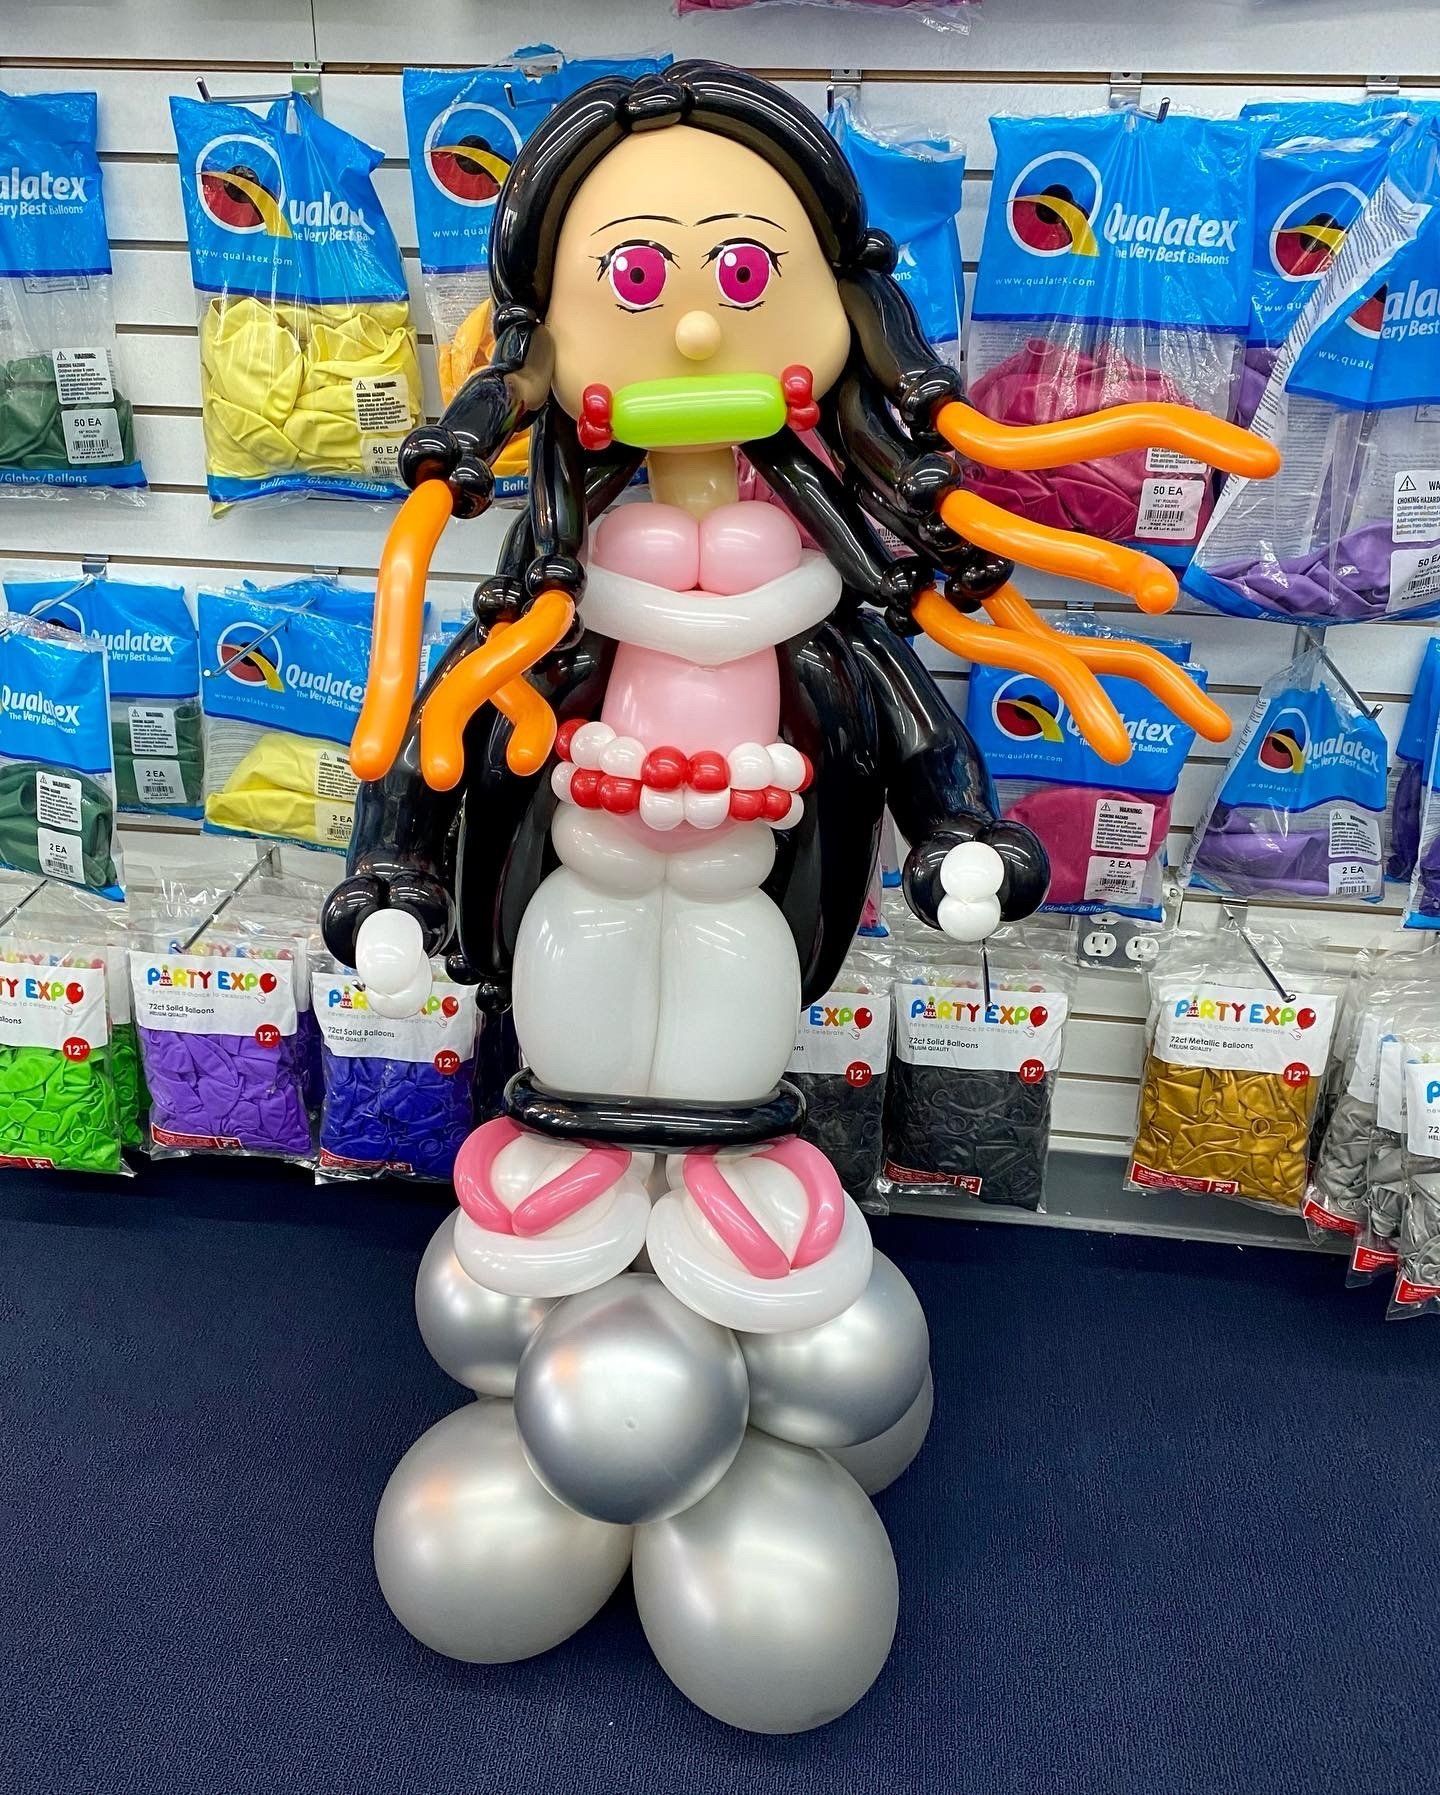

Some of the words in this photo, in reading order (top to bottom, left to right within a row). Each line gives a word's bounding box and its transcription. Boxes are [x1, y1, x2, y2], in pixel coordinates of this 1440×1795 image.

[21, 202, 47, 215] Best
[49, 205, 84, 215] Balloons
[432, 225, 491, 239] www.qual
[1104, 202, 1239, 252] Qualatex
[294, 230, 303, 241] he
[304, 228, 329, 246] Very
[329, 228, 352, 242] Best
[196, 249, 293, 266] www.qualatex.com
[1128, 244, 1155, 263] Very
[1156, 246, 1187, 263] Best
[1187, 252, 1230, 266] Balloons
[996, 276, 1095, 287] www.qualatex.com
[1384, 280, 1440, 321] ala
[1408, 320, 1440, 336] Best
[1316, 350, 1374, 371] ww.quala
[74, 419, 85, 427] 50
[88, 418, 102, 427] EA
[387, 446, 399, 454] EA
[1153, 486, 1165, 495] 50
[1168, 486, 1184, 496] EA
[1398, 497, 1420, 505] CHOKING
[1418, 558, 1429, 568] 50
[112, 652, 129, 663] Very
[129, 652, 146, 662] Best
[286, 664, 367, 704] Qualate
[1, 684, 81, 727] Qualatex
[296, 690, 309, 699] The
[310, 690, 326, 706] Very
[327, 694, 344, 710] Best
[9, 711, 22, 721] The
[23, 710, 41, 726] Very
[41, 715, 56, 727] Best
[1066, 713, 1177, 746] Qatex
[1138, 744, 1169, 754] Balloons
[1304, 733, 1380, 774] Qualatex
[984, 752, 1063, 763] www.qualatex.com
[1321, 756, 1338, 766] Very
[1339, 756, 1356, 767] Best
[146, 770, 152, 778] 2
[153, 770, 166, 778] EA
[332, 814, 338, 822] 2
[340, 815, 352, 824] EA
[49, 843, 54, 851] 2
[55, 844, 68, 855] EA
[1110, 860, 1115, 868] 2
[1118, 861, 1132, 869] EA
[1342, 866, 1348, 875] 2
[1350, 866, 1364, 874] EA
[147, 966, 212, 989] PARTY
[218, 970, 278, 994] EXPO
[26, 978, 84, 1005] EXPO
[149, 1003, 165, 1012] 72ct
[166, 1004, 184, 1012] Solid
[185, 1006, 215, 1014] Balloons
[328, 988, 369, 1011] PAR
[421, 996, 460, 1018] PO
[810, 1006, 873, 1030] EXPO
[911, 999, 980, 1023] PARTY
[984, 1004, 1049, 1028] EXPO
[1174, 1000, 1246, 1022] PARTY
[1250, 1004, 1317, 1030] EXPO
[258, 1032, 278, 1042] 12"
[328, 1026, 343, 1036] 72ct
[344, 1027, 362, 1037] Solid
[364, 1028, 395, 1038] Balloons
[909, 1037, 925, 1045] 72ct
[926, 1037, 945, 1046] Solid
[947, 1040, 979, 1049] Balloons
[1171, 1036, 1187, 1044] 72ct
[1188, 1037, 1220, 1048] Metallic
[1223, 1040, 1254, 1049] Balloons
[66, 1045, 88, 1056] 12"
[437, 1058, 458, 1068] 12"
[849, 1070, 870, 1080] 12"
[1022, 1067, 1043, 1078] 12"
[1286, 1070, 1308, 1081] 12"
